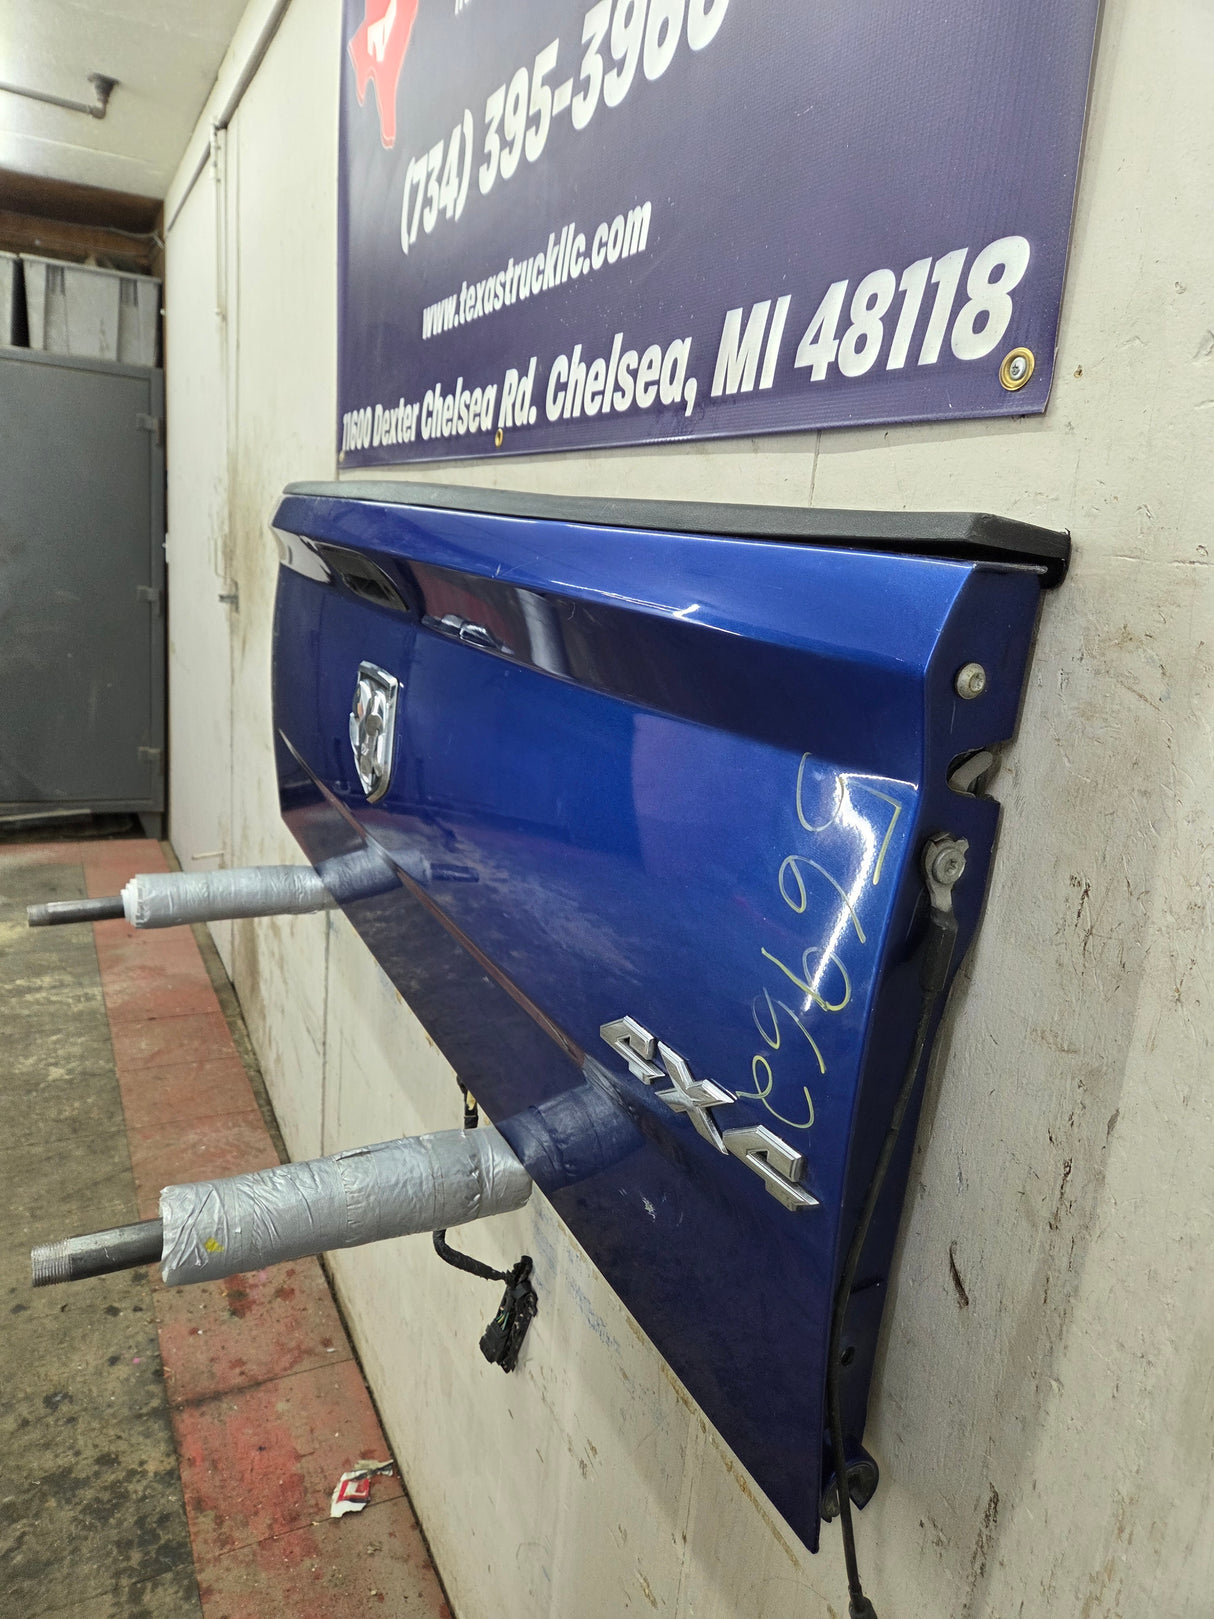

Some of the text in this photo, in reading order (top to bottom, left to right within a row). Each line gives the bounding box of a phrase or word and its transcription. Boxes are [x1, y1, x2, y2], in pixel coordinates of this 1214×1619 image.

[401, 109, 473, 255] (734)
[343, 235, 1031, 451] 11600 Dexter Chelsea Rd. Chelsea, MI 48118
[422, 201, 652, 340] www.texastruckllc.com
